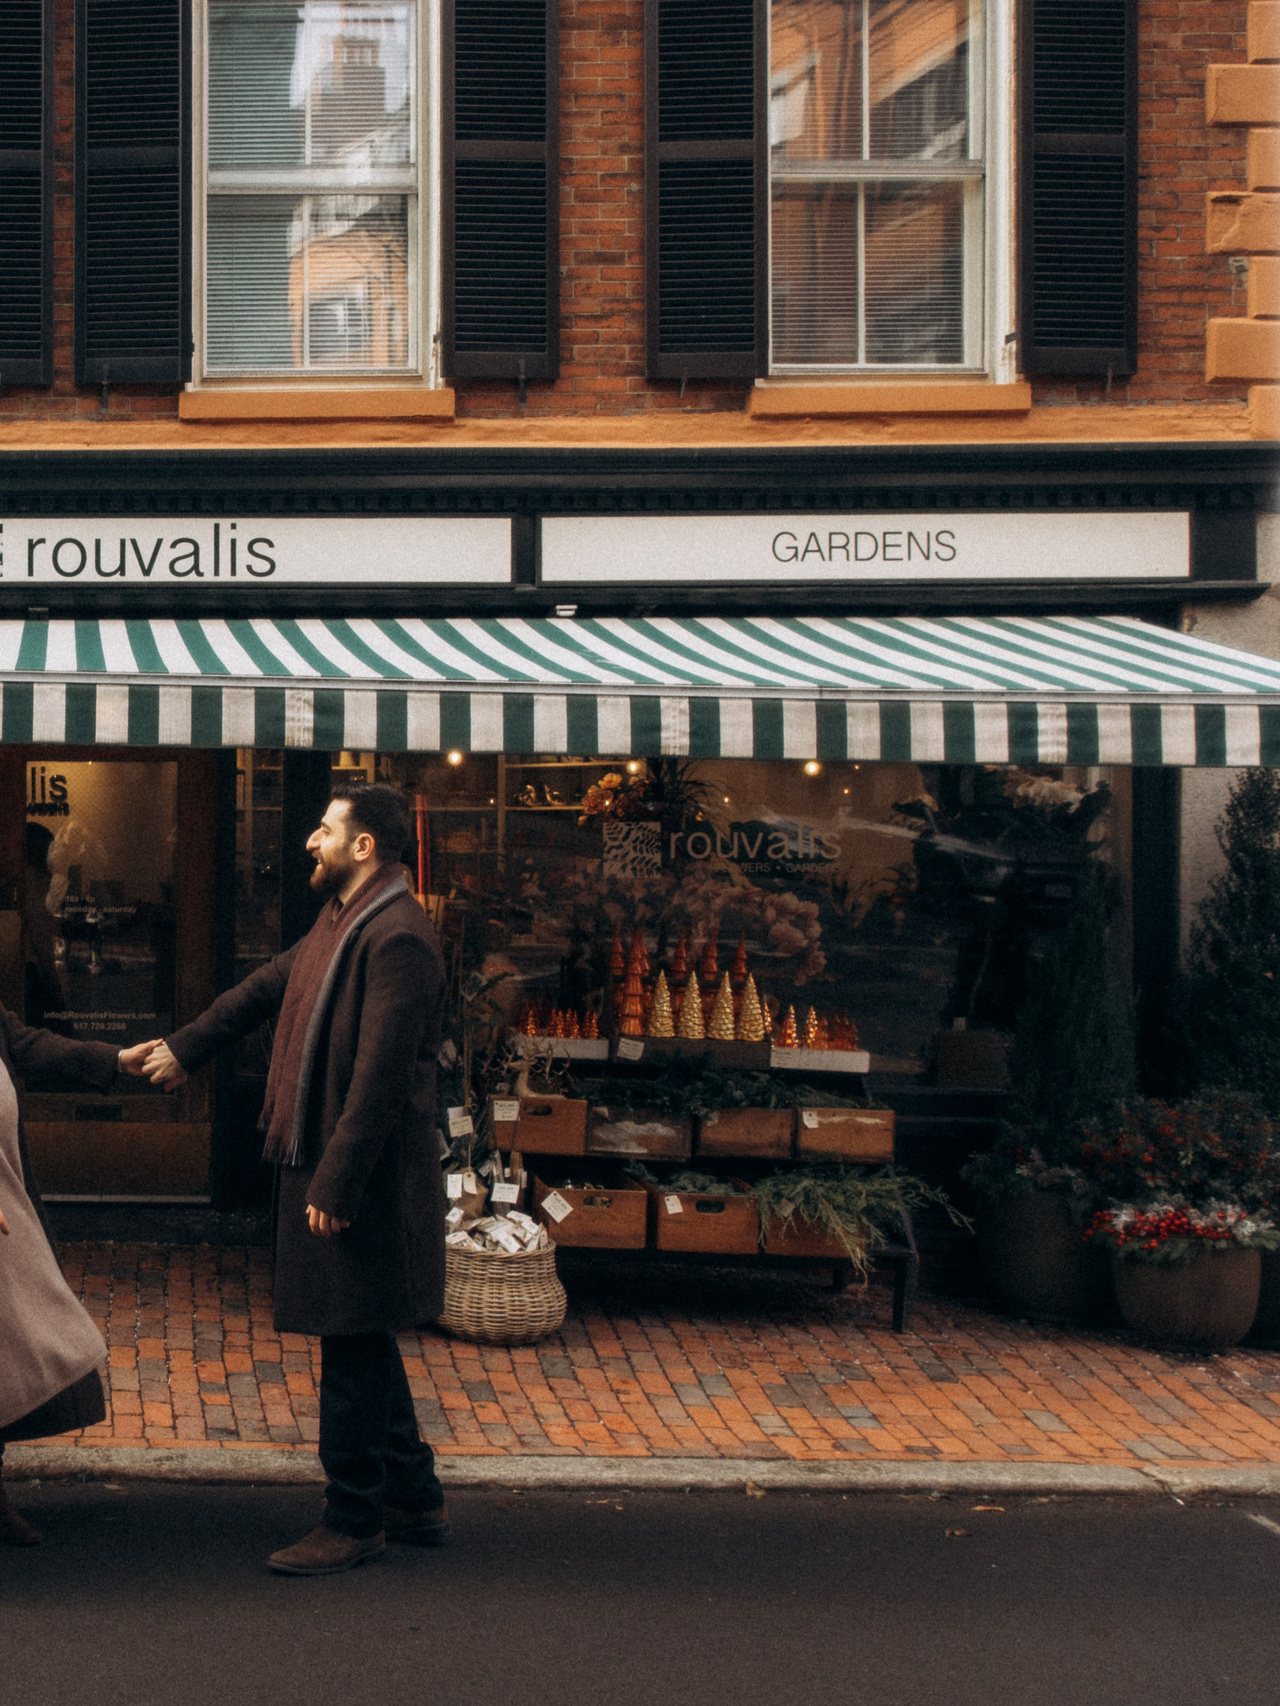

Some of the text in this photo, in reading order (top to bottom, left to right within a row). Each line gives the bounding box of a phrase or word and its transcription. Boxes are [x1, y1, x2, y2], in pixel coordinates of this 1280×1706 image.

[27, 522, 276, 577] rouvalis
[772, 530, 956, 562] GARDENS
[670, 822, 842, 860] rouvalis
[65, 906, 97, 914] monday
[103, 906, 137, 914] saturday
